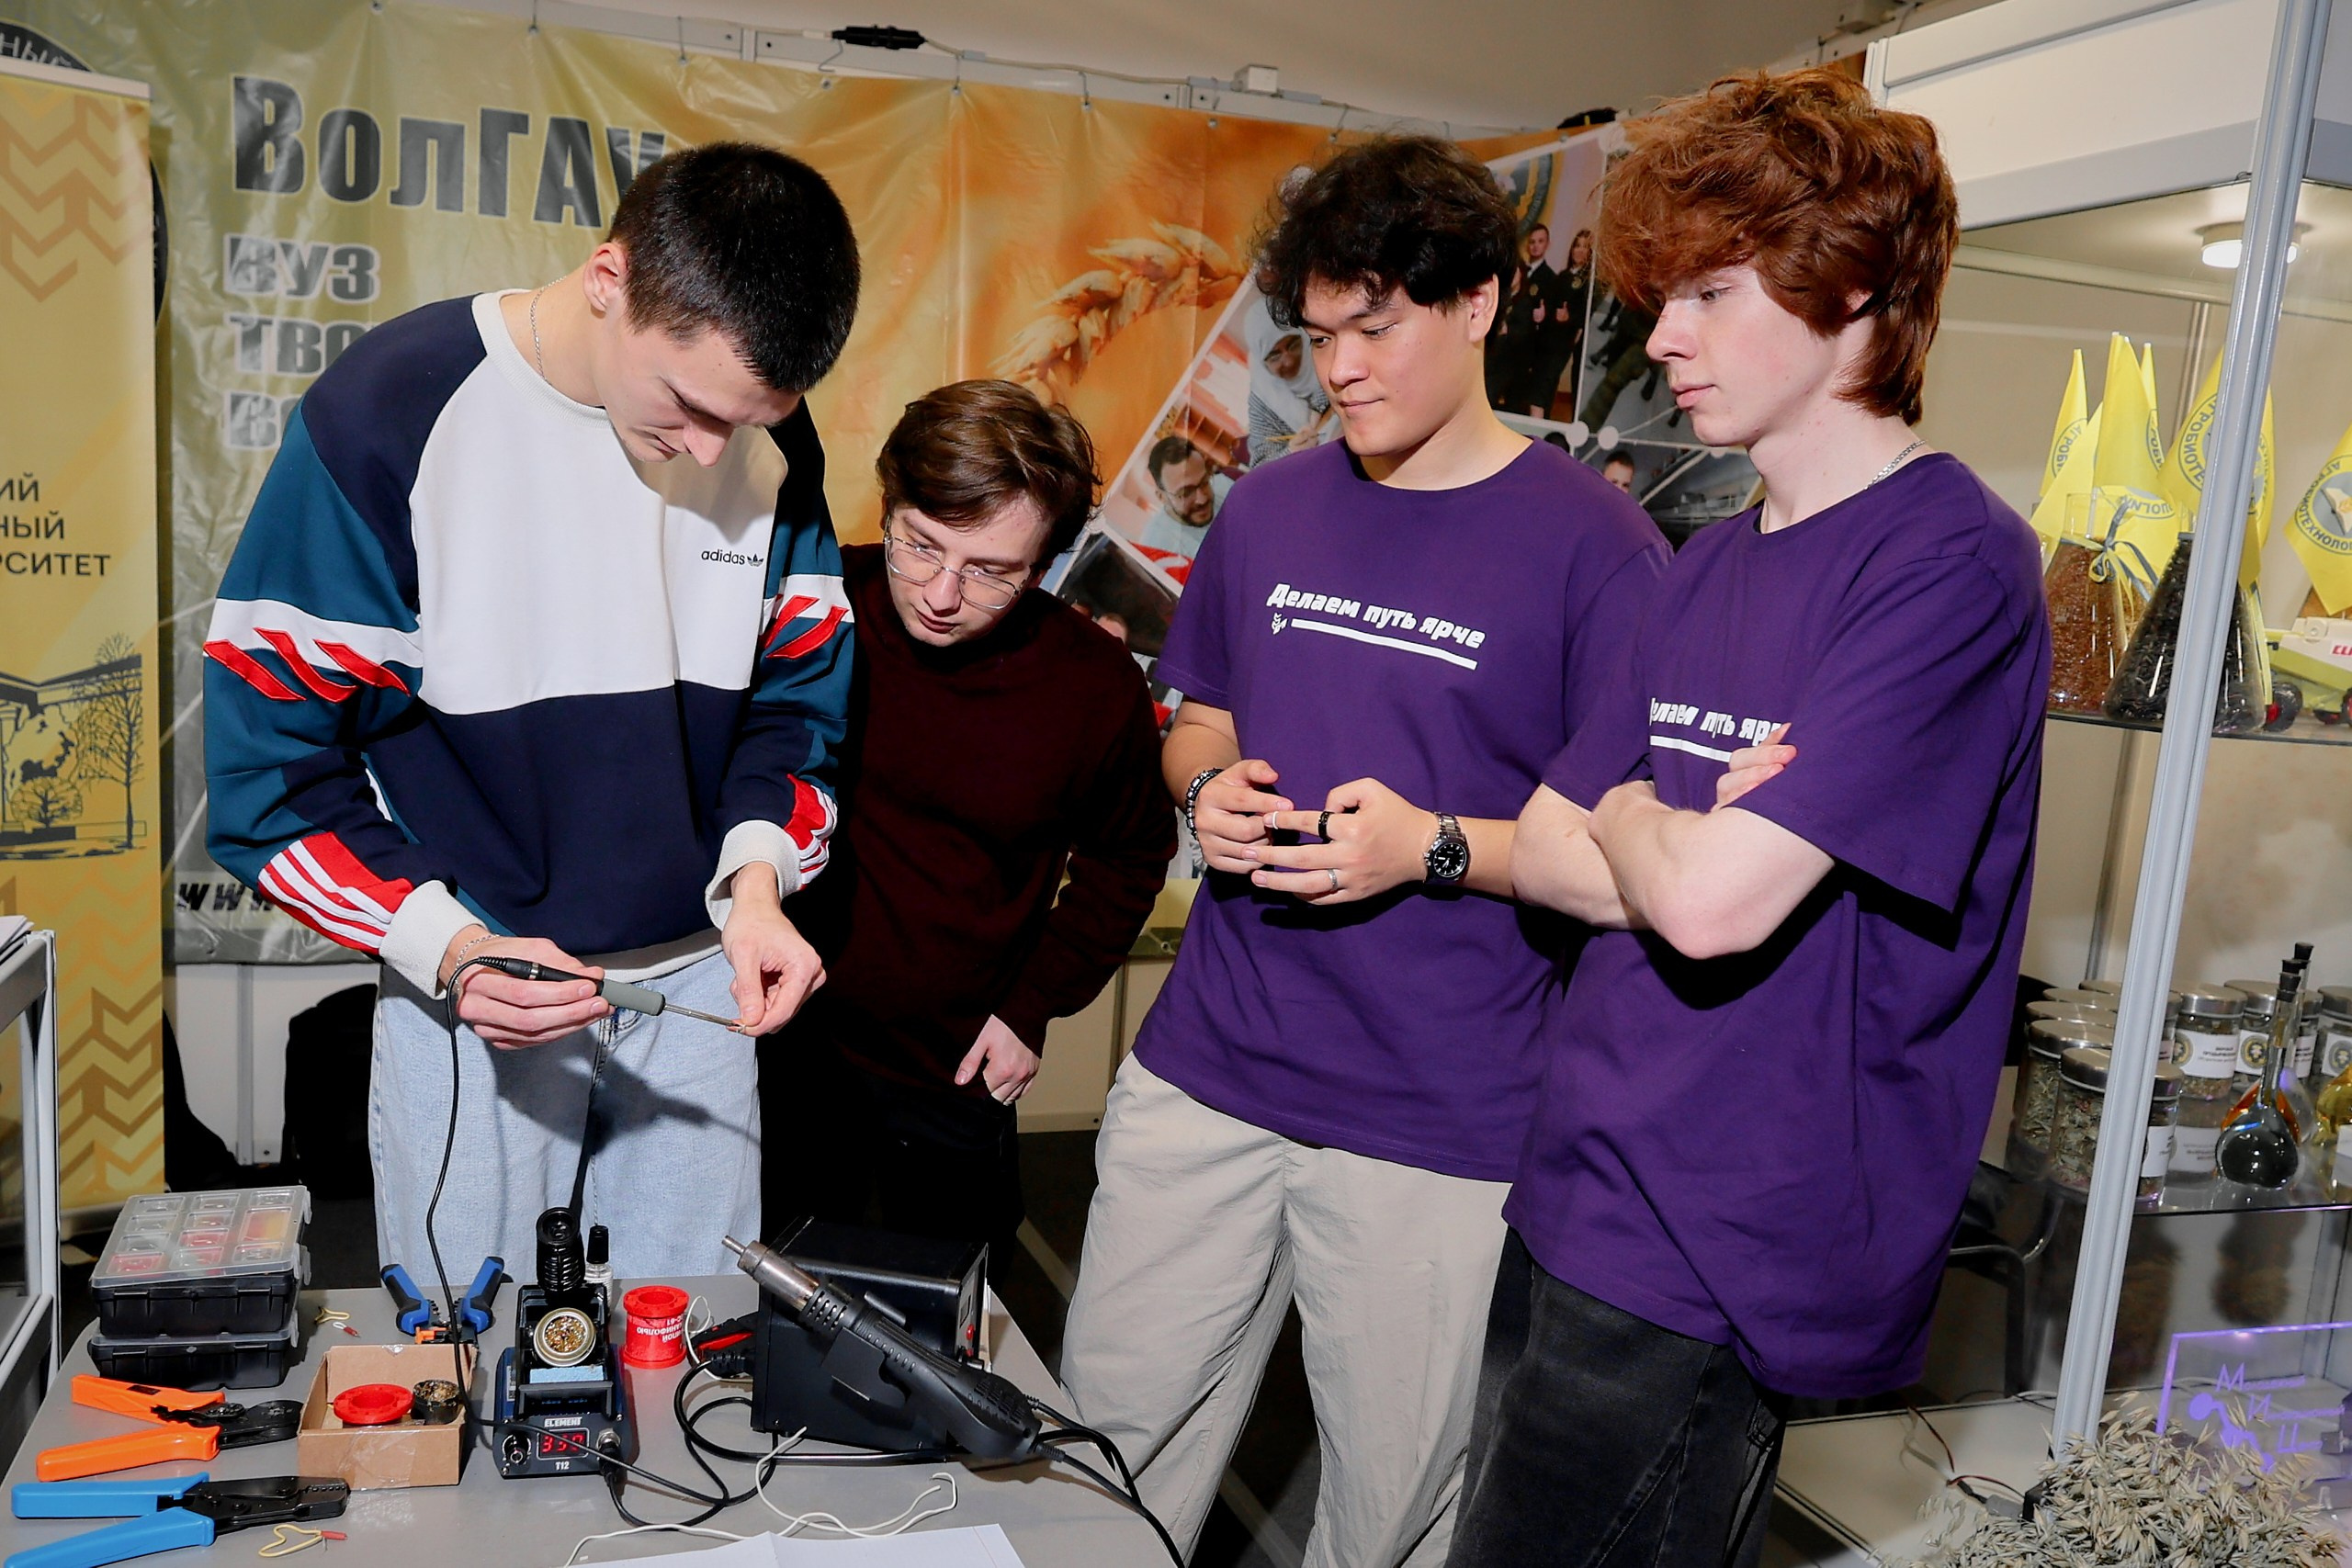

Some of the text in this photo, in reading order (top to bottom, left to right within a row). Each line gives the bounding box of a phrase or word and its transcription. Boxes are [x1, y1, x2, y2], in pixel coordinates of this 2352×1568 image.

[230, 316, 373, 374] ТВО
[2298, 460, 2352, 551] АГРОБИОТЕХНОЛО
[0, 552, 111, 577] СИТЕТ
[701, 548, 746, 565] adidas
[1266, 583, 1486, 649] Делаем путь ярче
[1700, 702, 1736, 739] пть
[544, 1416, 582, 1427] ELEMENT
[555, 1461, 570, 1471] T12
